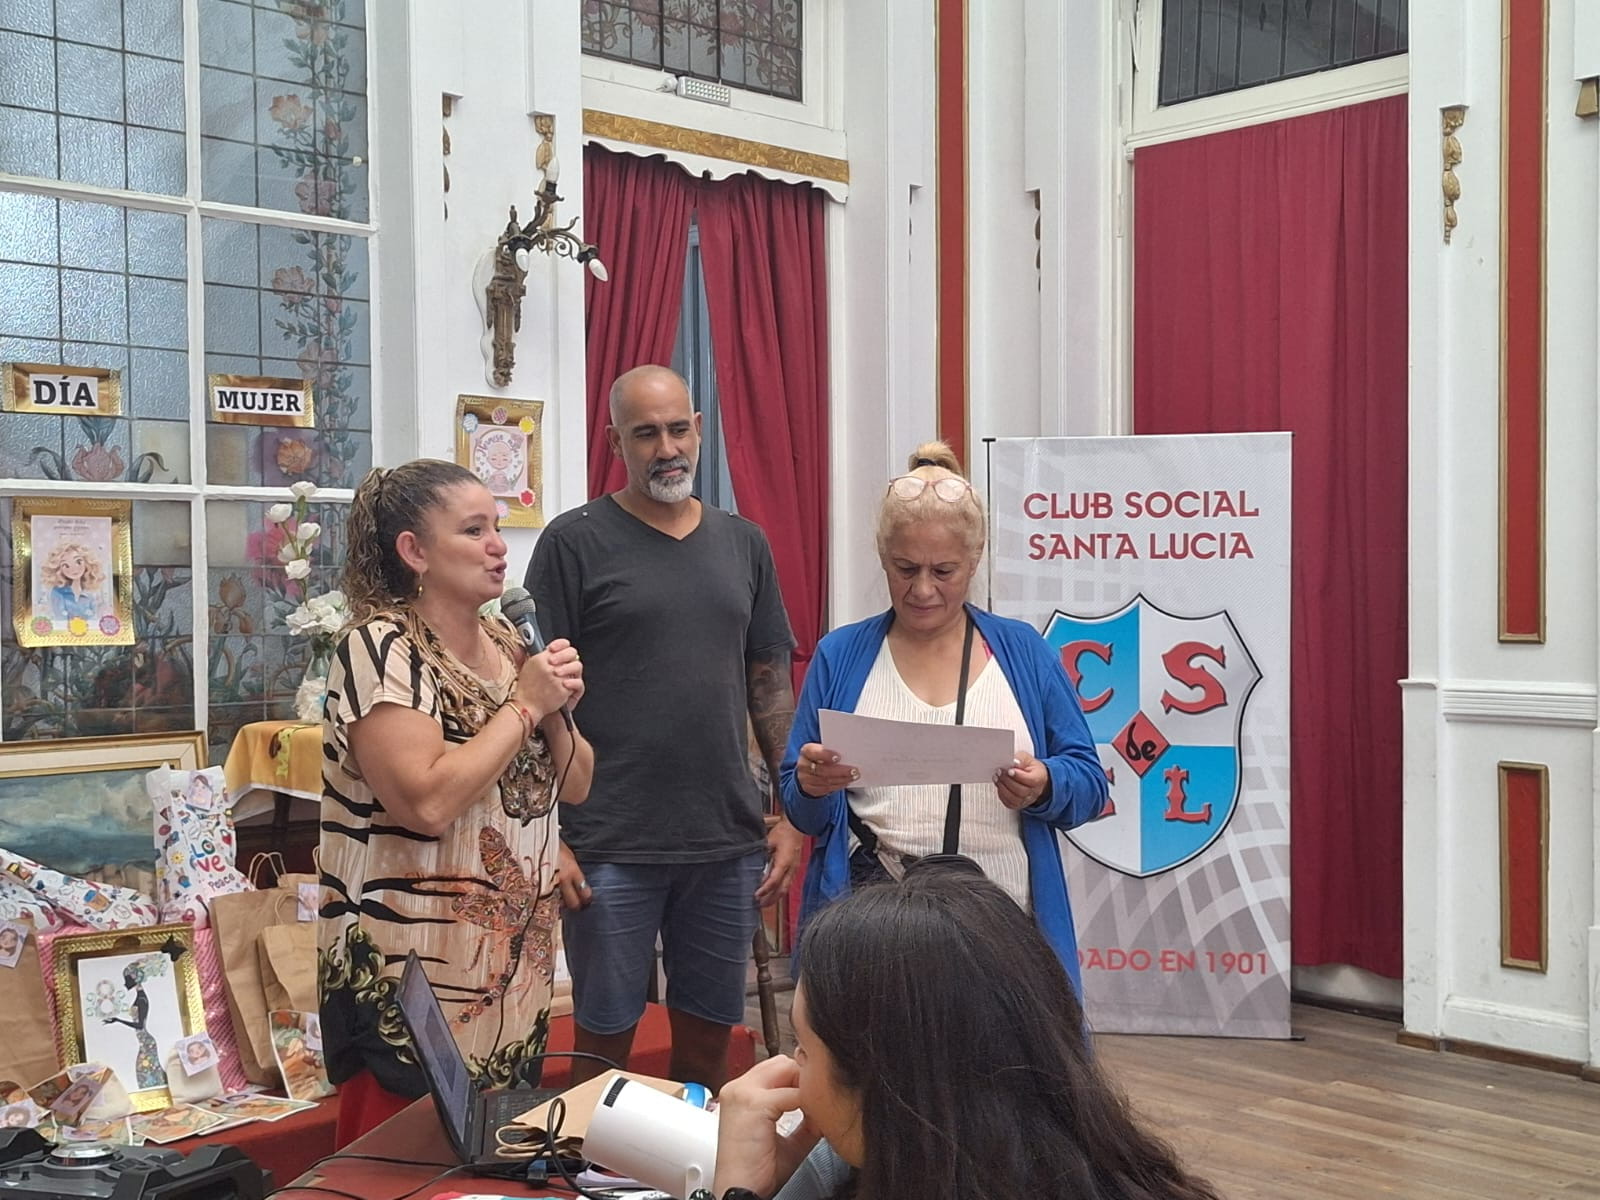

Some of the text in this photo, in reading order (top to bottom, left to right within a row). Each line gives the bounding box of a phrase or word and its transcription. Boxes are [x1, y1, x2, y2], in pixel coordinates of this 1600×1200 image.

[33, 375, 96, 407] DÍA
[217, 390, 302, 412] MUJER
[1023, 490, 1260, 520] CLUB SOCIAL
[1028, 532, 1254, 560] SANTA LUCIA
[1060, 640, 1229, 715] C S
[1125, 722, 1157, 761] de
[1164, 764, 1212, 825] L
[1078, 948, 1267, 975] ADO EN 1901
